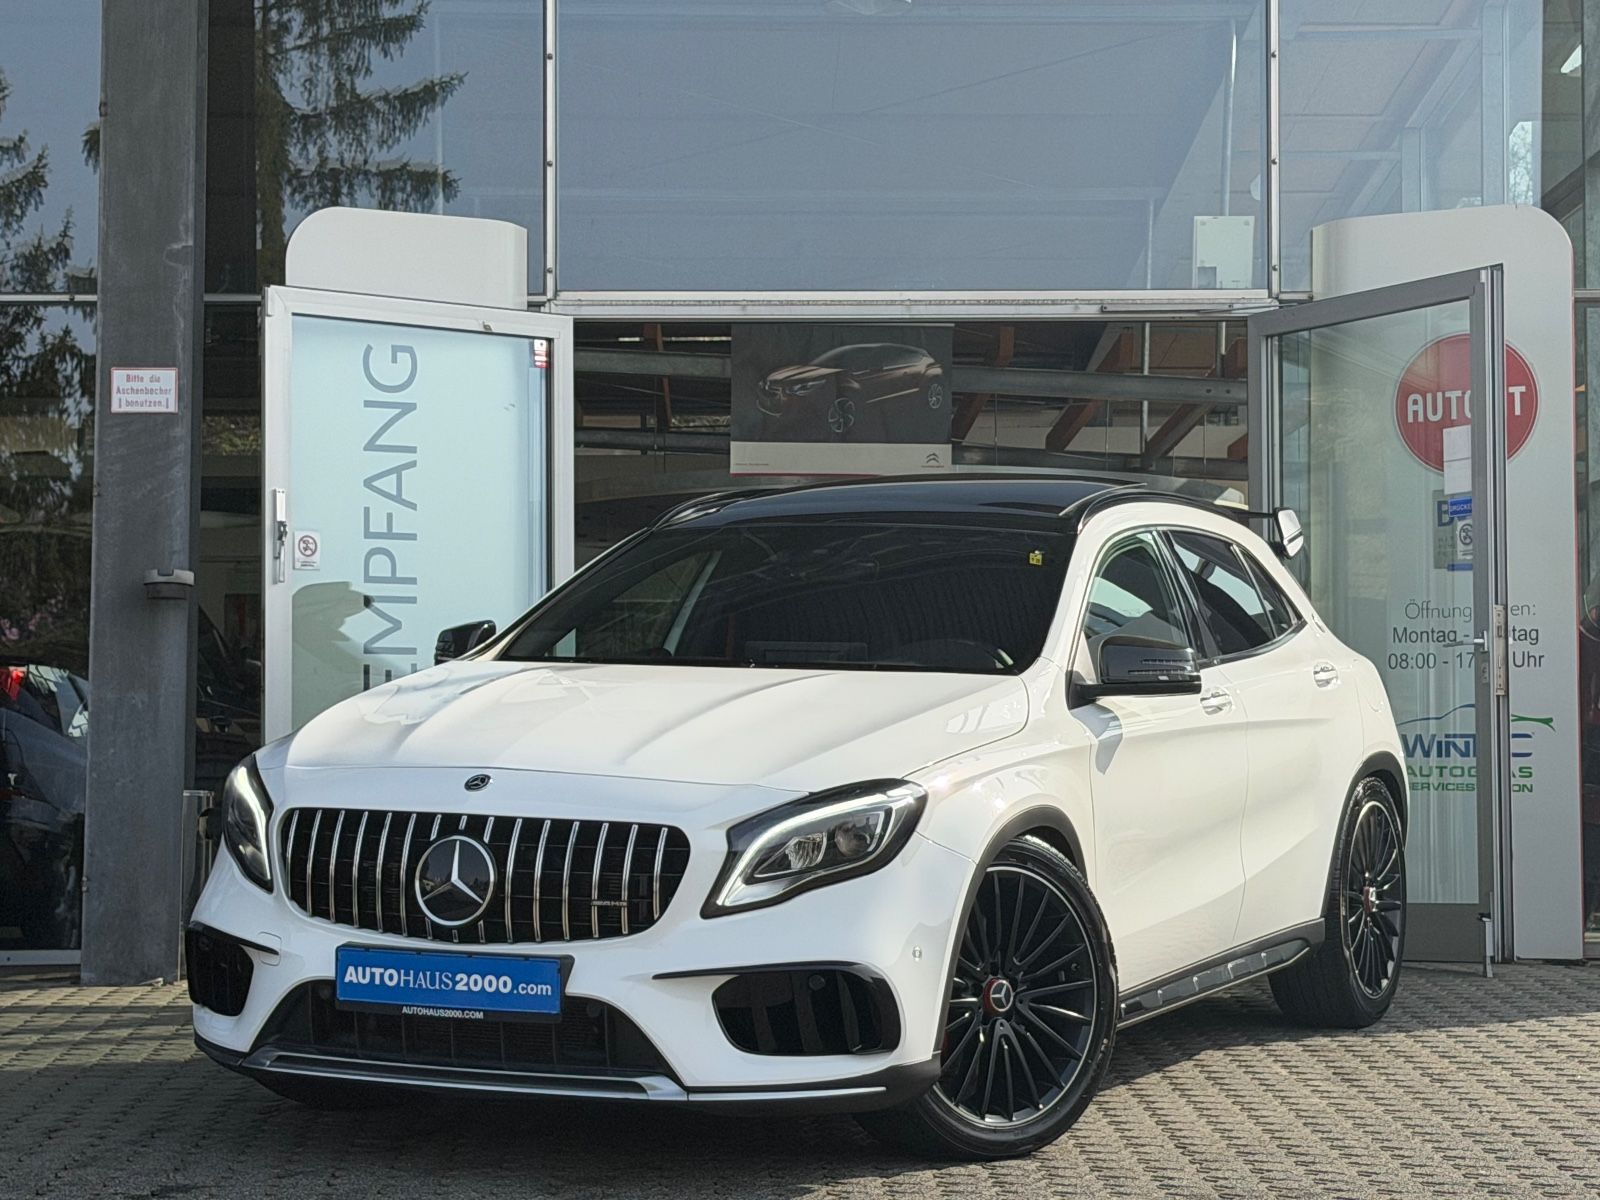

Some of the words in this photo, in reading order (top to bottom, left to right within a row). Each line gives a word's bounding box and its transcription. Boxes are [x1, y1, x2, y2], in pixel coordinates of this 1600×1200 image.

[126, 374, 144, 383] Bitte
[149, 374, 161, 383] die
[1407, 385, 1526, 423] AUTT
[1405, 599, 1536, 623] Öffnungen:
[1392, 627, 1457, 643] Montag
[1388, 652, 1437, 670] 08:00
[1512, 651, 1545, 668] Uhr
[401, 1005, 484, 1020] AUTOHAUS2000.COM
